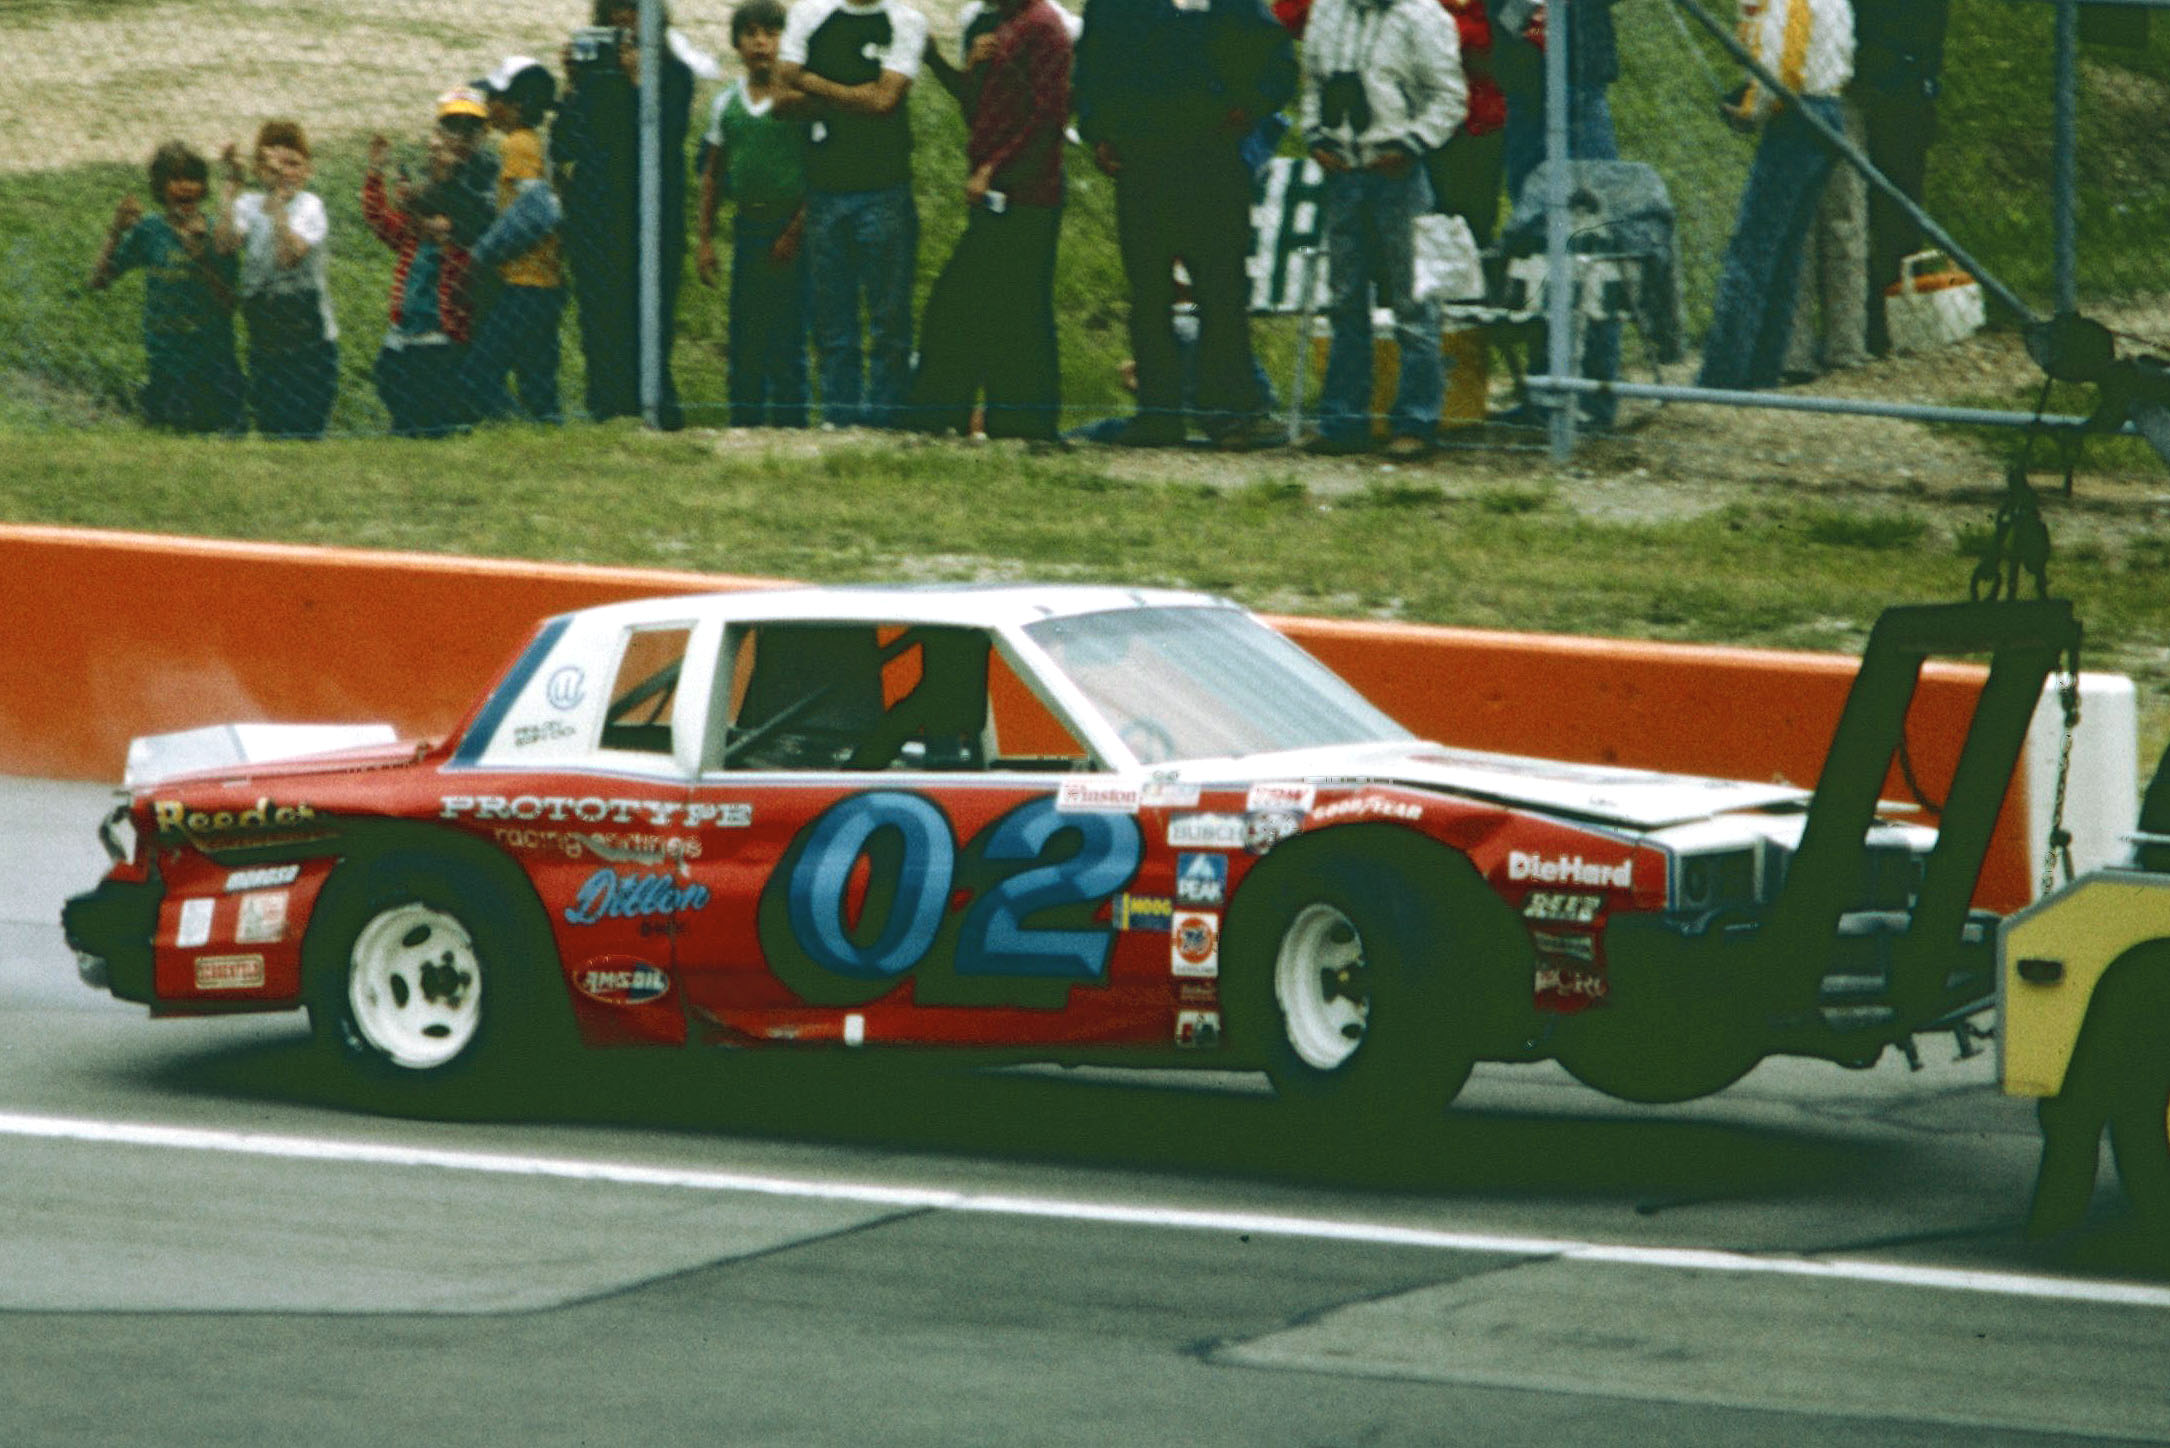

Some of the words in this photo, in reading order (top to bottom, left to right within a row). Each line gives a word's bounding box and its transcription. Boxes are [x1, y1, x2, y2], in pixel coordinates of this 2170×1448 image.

[438, 796, 753, 828] PROTOTYPE
[1313, 796, 1423, 820] GOODYEAR
[777, 788, 1143, 984] 02
[1509, 850, 1633, 889] DieHard
[564, 868, 710, 925] Dillon
